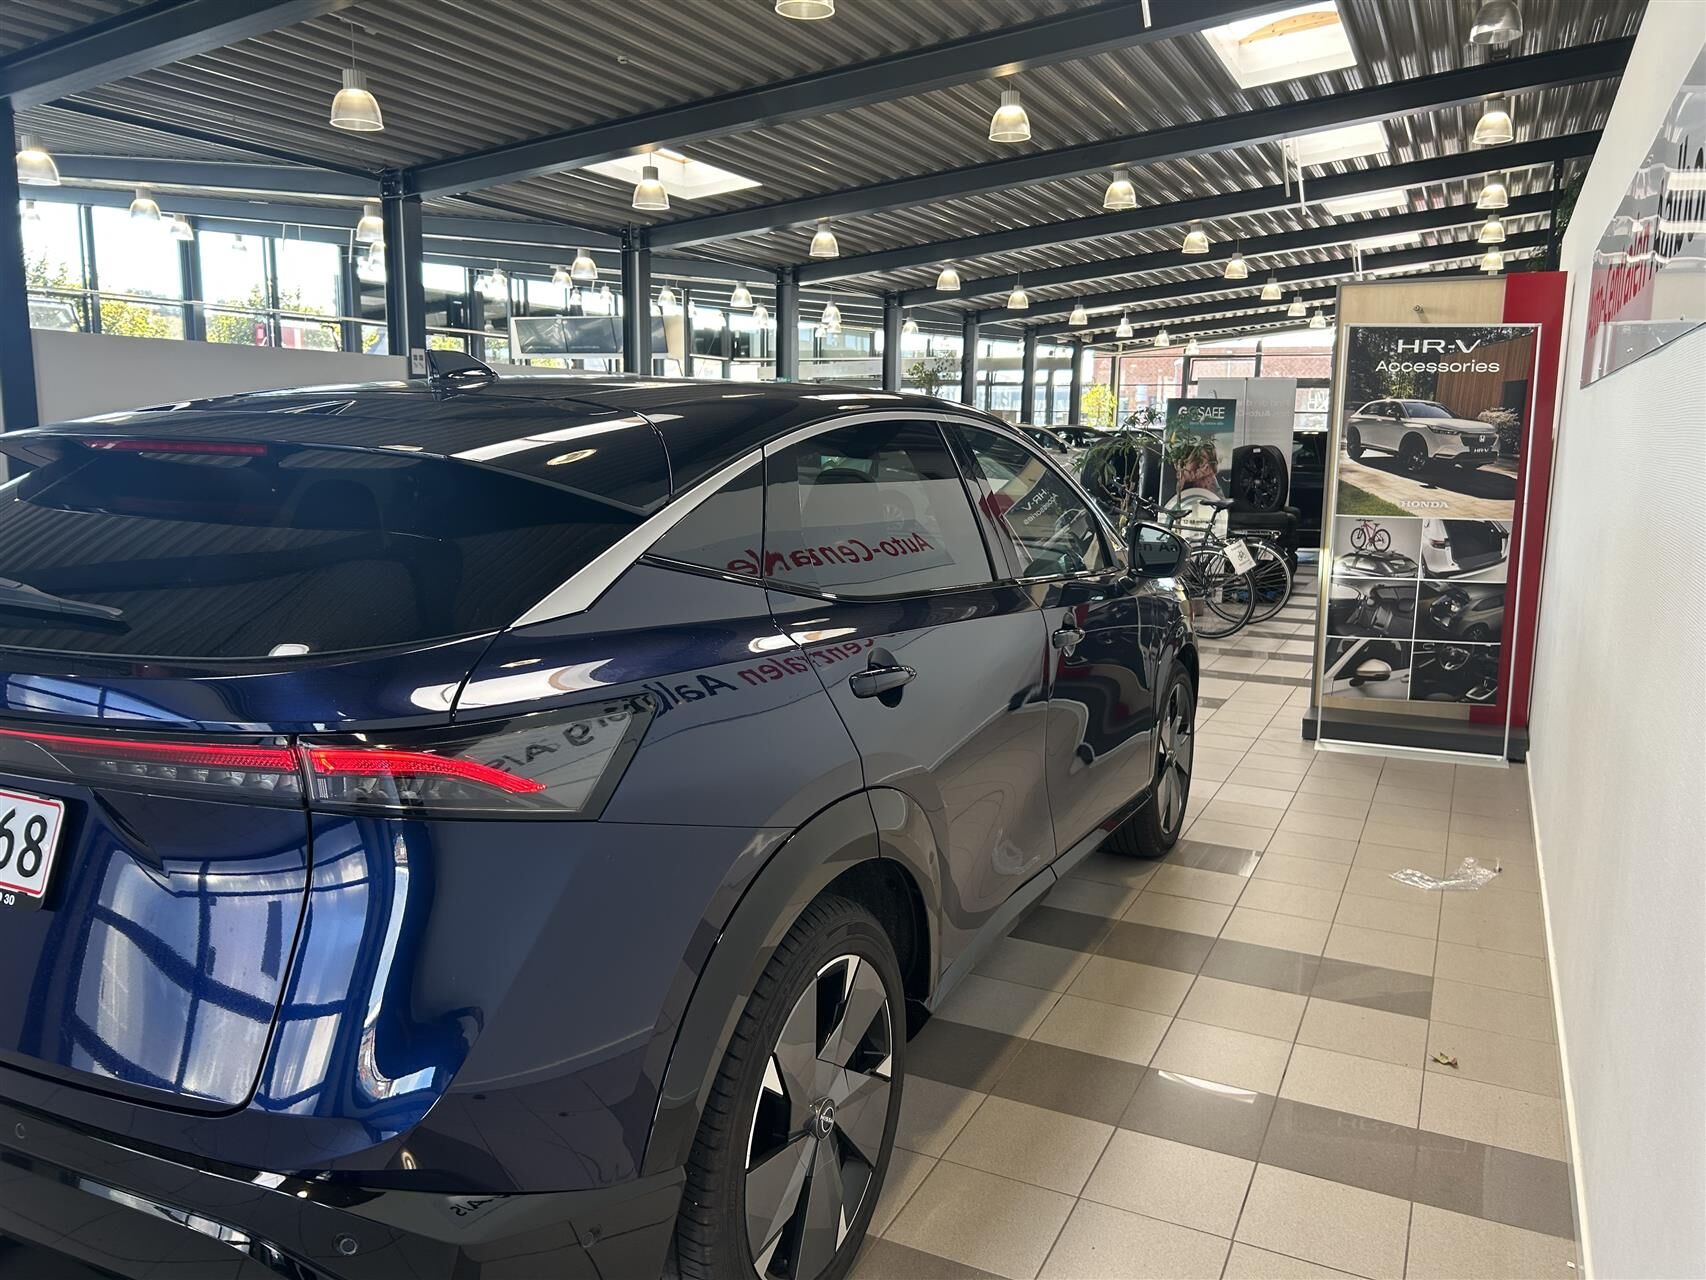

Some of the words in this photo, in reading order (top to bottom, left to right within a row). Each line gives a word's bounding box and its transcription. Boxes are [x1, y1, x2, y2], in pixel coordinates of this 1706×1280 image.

[1397, 339, 1481, 354] HR-V
[1375, 360, 1500, 373] Accessories
[1400, 500, 1449, 508] HONDA
